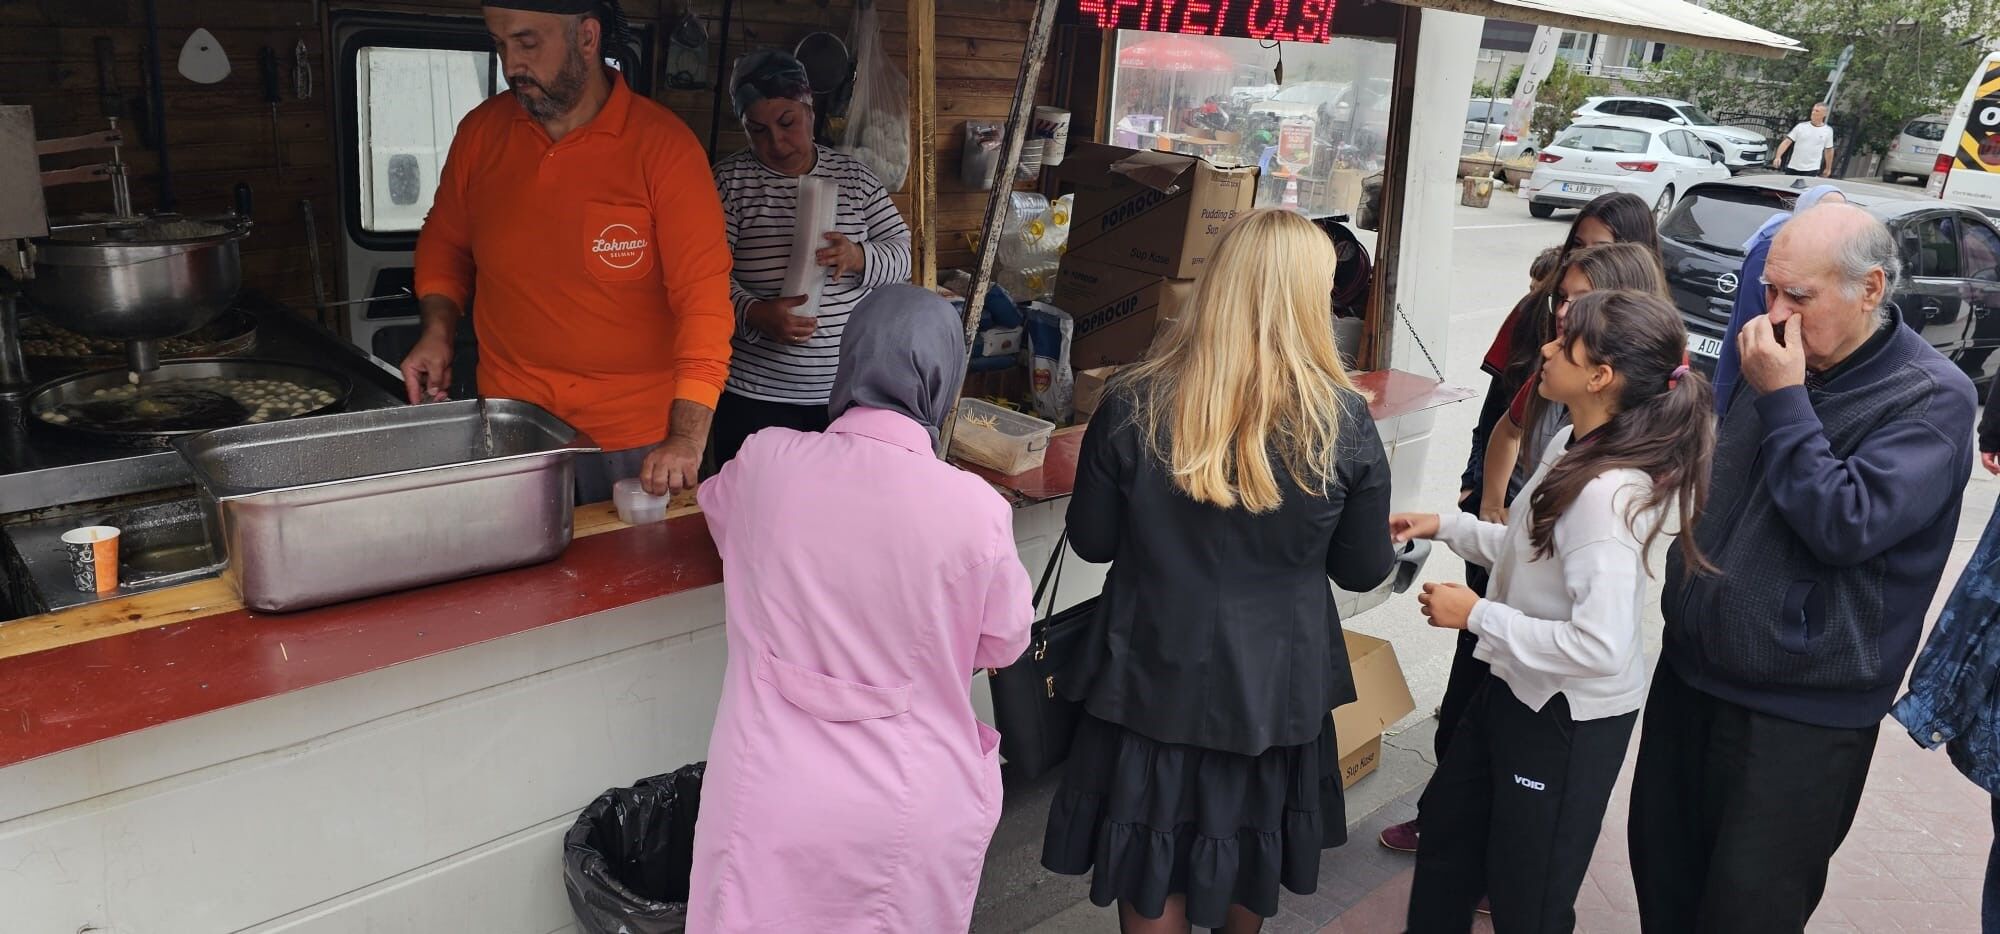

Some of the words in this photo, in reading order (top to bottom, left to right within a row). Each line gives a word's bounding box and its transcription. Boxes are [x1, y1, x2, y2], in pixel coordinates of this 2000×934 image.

[1201, 208, 1228, 222] Pudding
[1130, 246, 1148, 261] Sup
[1149, 250, 1170, 265] Kase
[1073, 295, 1138, 337] POPROCUP
[1346, 763, 1359, 779] Sup
[1360, 752, 1375, 769] Kase
[1514, 774, 1545, 791] VOID
